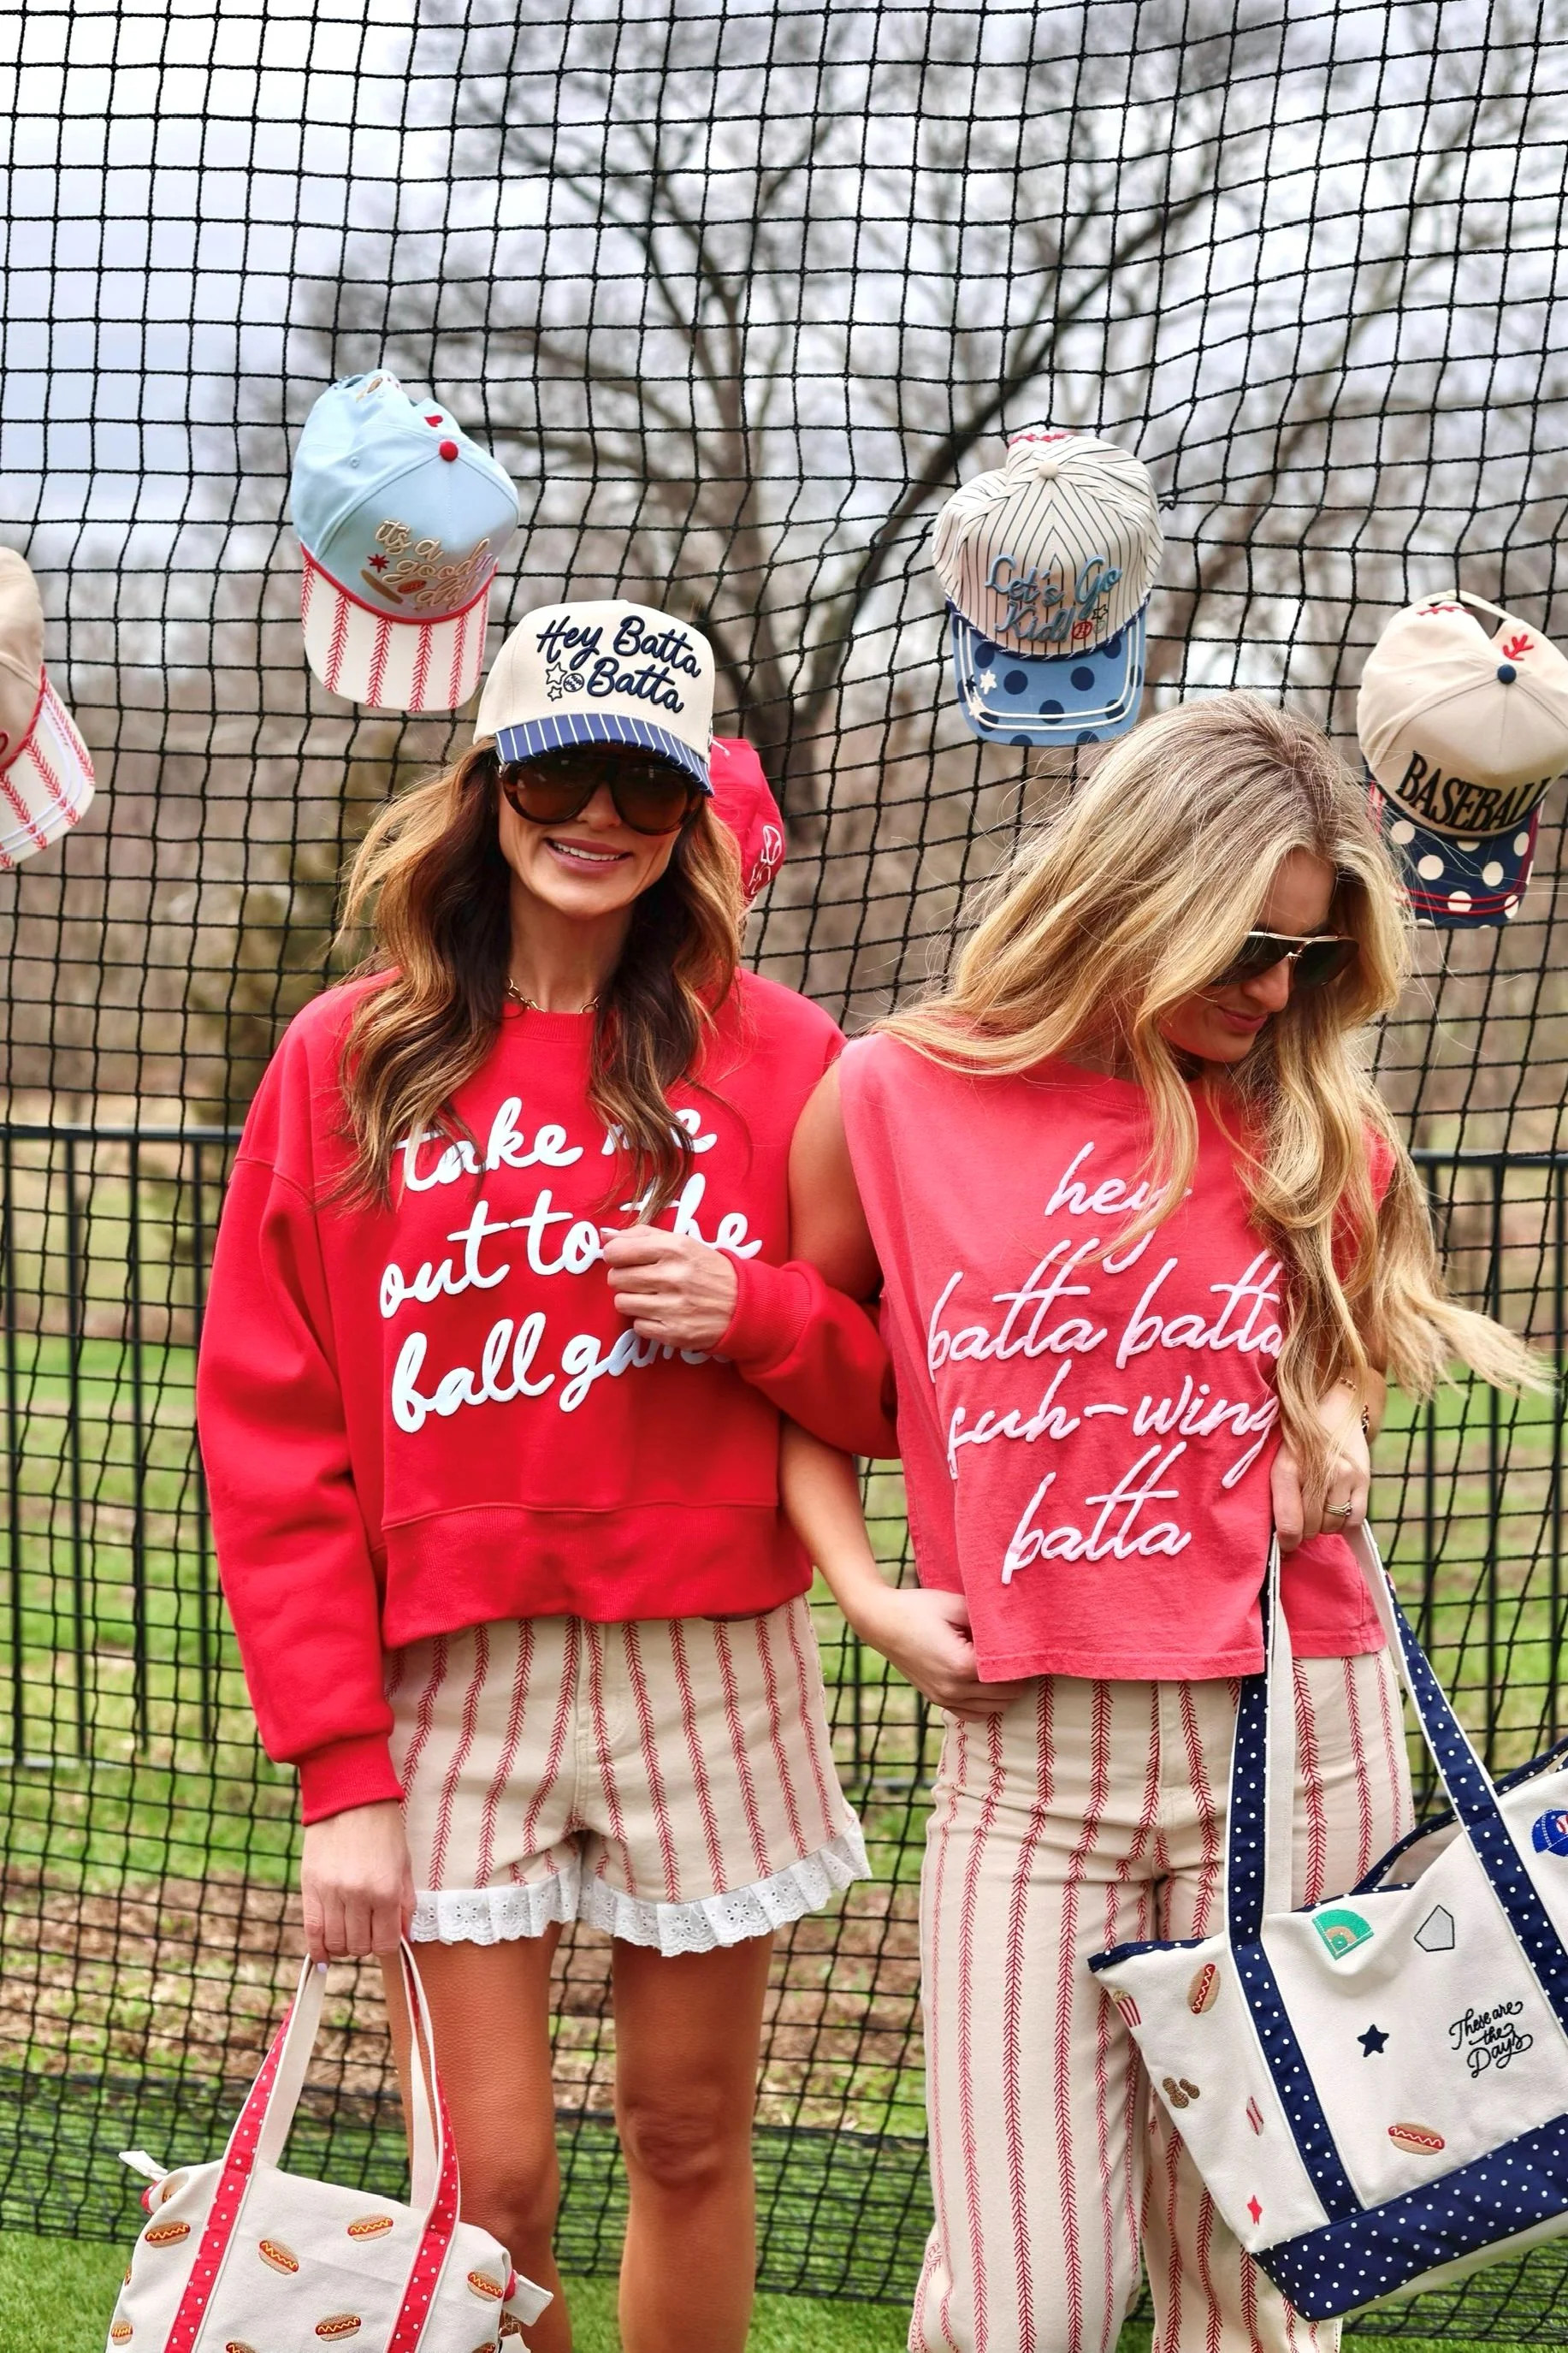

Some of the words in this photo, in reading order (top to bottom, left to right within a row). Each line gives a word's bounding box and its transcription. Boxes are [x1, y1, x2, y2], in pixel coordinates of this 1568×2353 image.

[382, 537, 490, 585] good
[414, 538, 445, 561] a
[984, 554, 1066, 608] Let's
[1074, 554, 1123, 620] Go
[535, 615, 604, 671] Hey
[612, 614, 701, 679] Batta
[586, 656, 684, 714] Batta
[393, 1096, 584, 1192] take
[1044, 1141, 1193, 1274] hey
[379, 1200, 512, 1319] out
[510, 1189, 606, 1276] to
[927, 1238, 1108, 1384] batta
[391, 1313, 555, 1434] ball
[558, 1328, 733, 1413] ga
[1001, 1441, 1192, 1585] batta
[1448, 2007, 1492, 2050] These
[1492, 2000, 1524, 2020] are
[1466, 2031, 1534, 2078] Days
[1468, 2022, 1515, 2046] the
